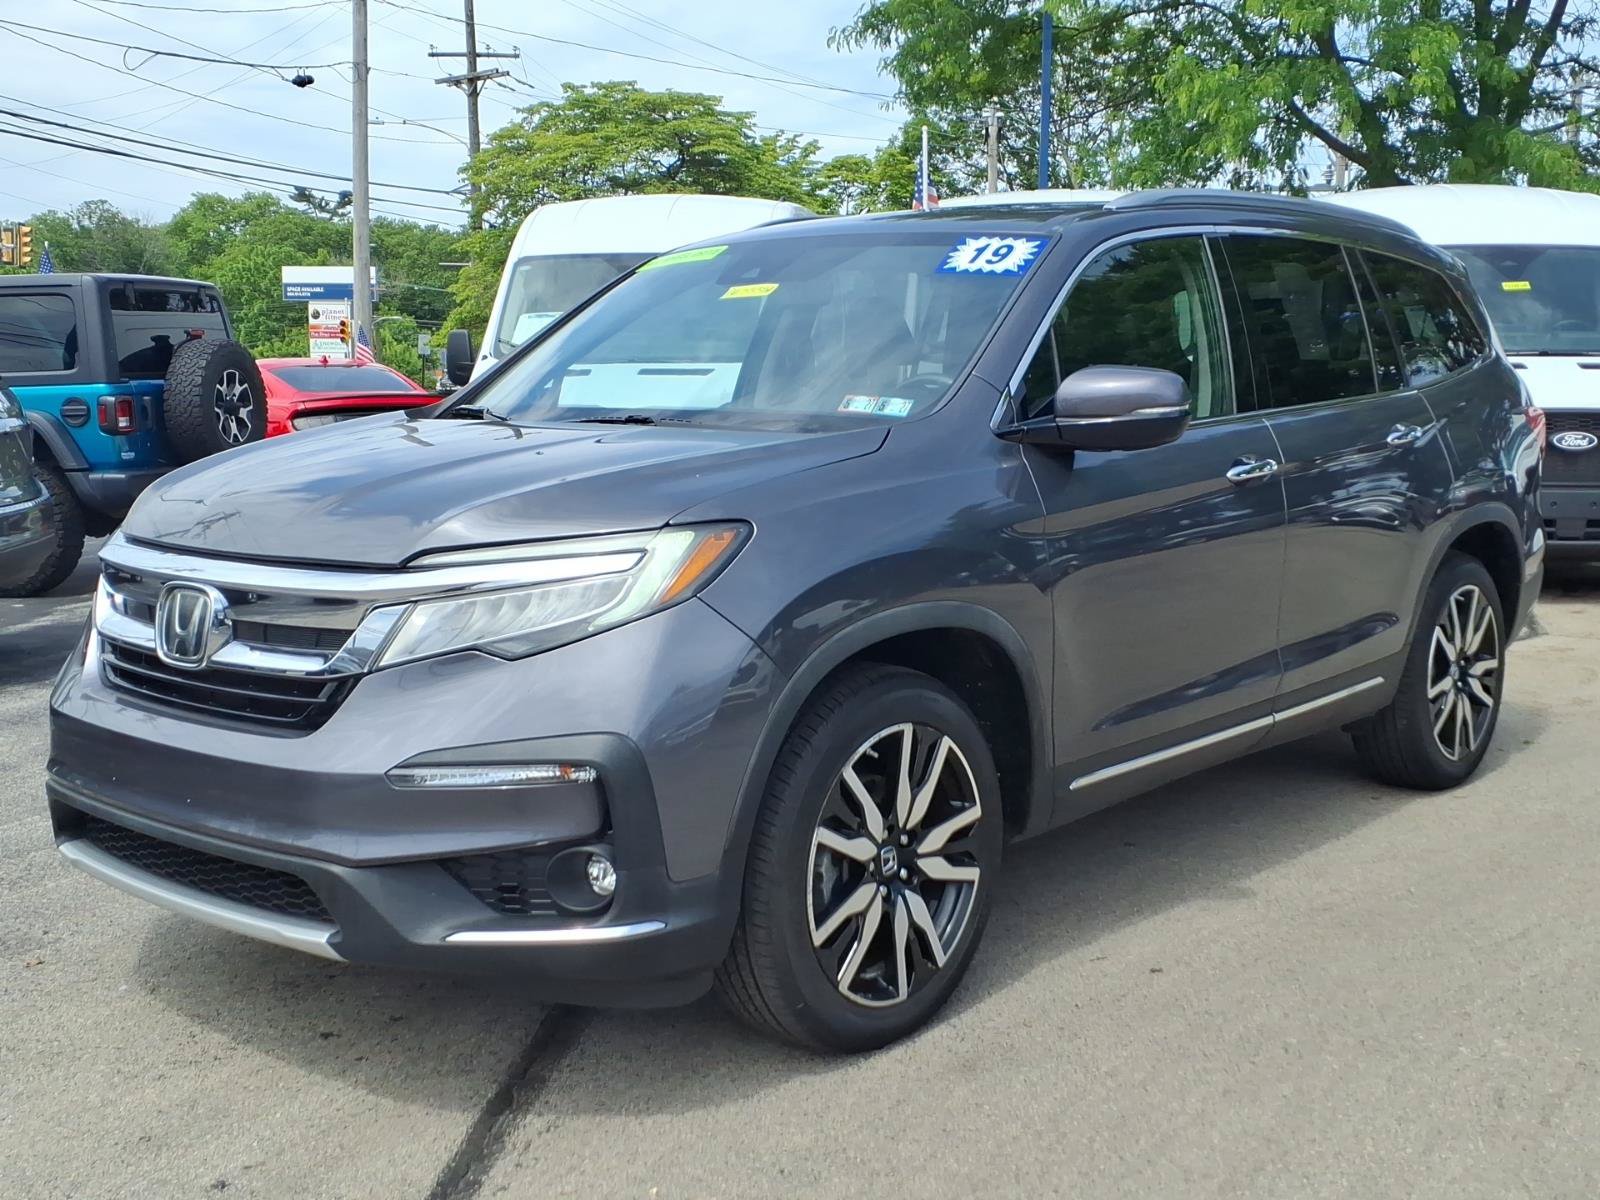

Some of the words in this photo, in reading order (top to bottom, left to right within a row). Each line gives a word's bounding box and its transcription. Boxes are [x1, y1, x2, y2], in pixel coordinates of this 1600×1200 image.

[968, 243, 1015, 265] 19
[322, 308, 344, 316] planet
[1562, 434, 1589, 446] Ford
